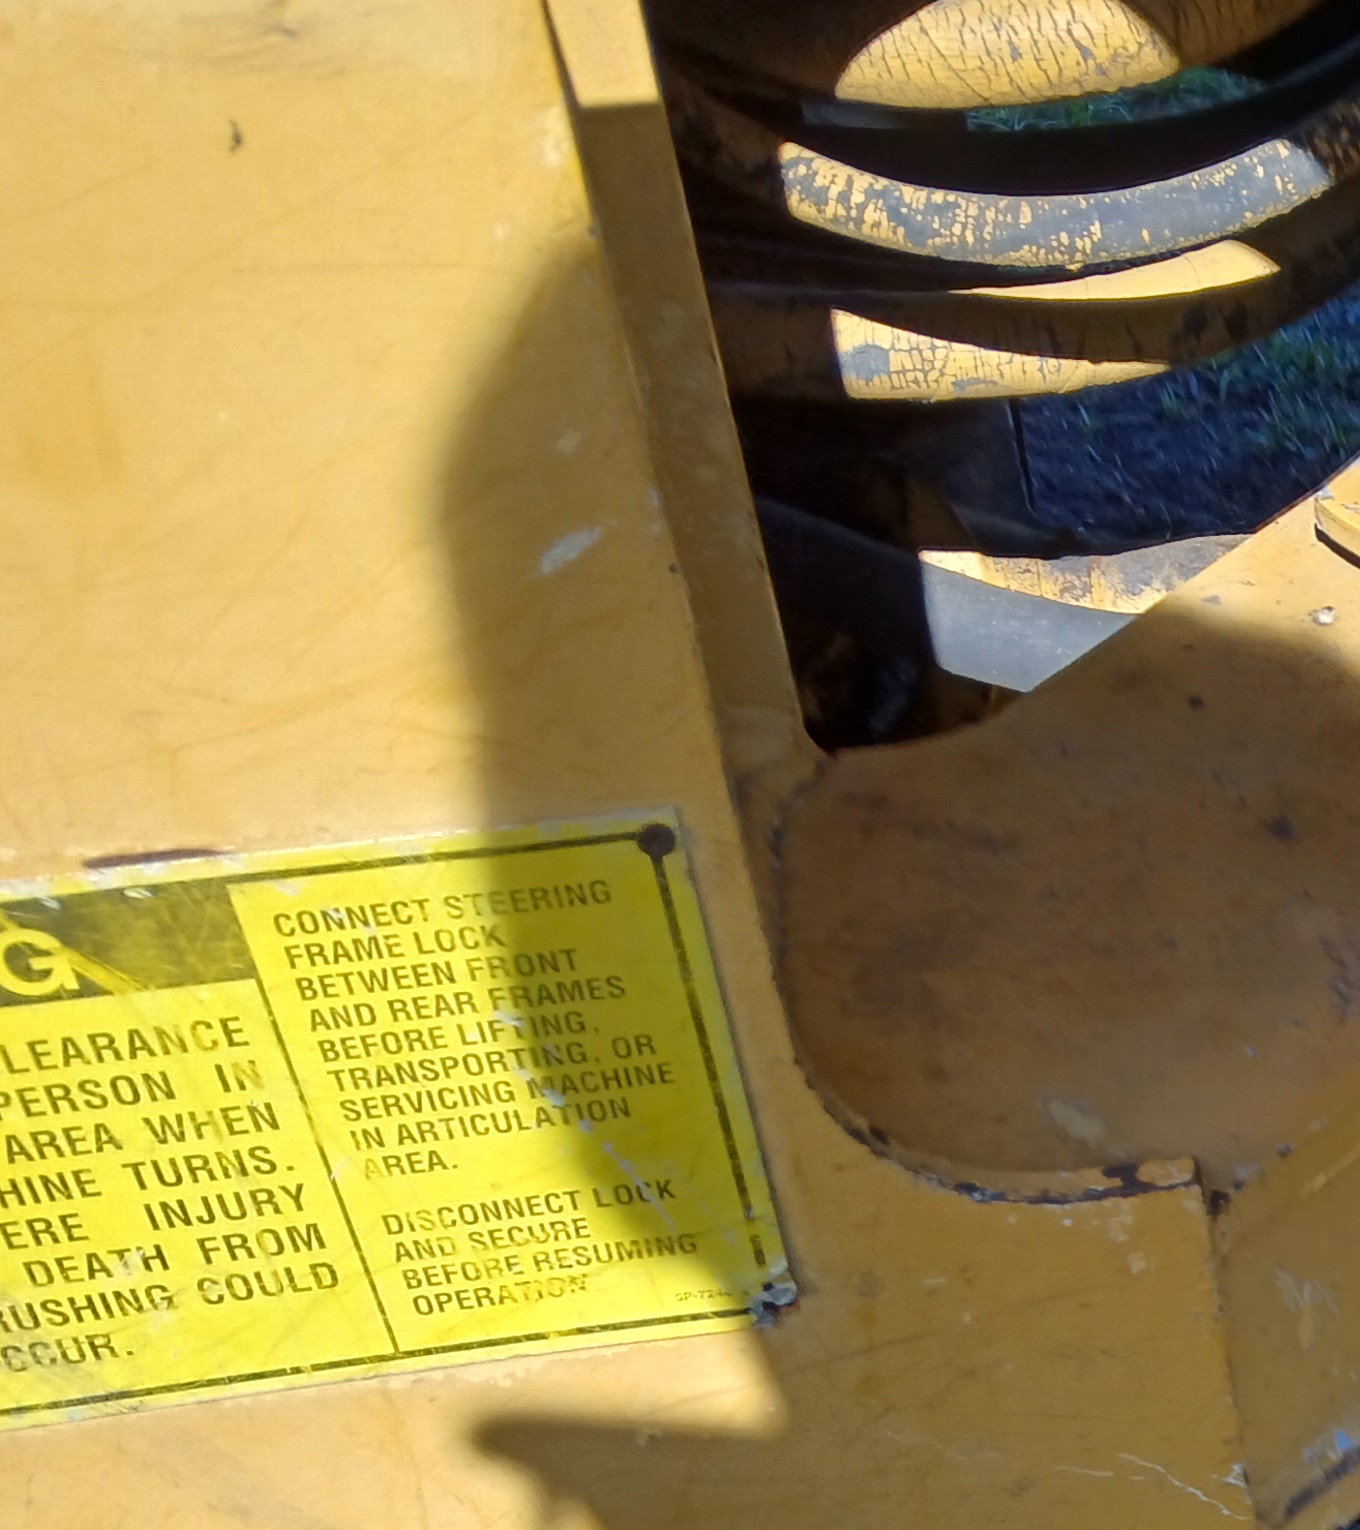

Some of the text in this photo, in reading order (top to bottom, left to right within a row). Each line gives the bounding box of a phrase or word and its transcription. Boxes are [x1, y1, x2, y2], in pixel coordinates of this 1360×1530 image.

[273, 879, 612, 937] CONNECT STEERING
[283, 923, 507, 969] FRAME LOCK
[295, 948, 577, 1001] BETWEEN FRONT
[310, 975, 627, 1032] AND REAR FRAMES
[317, 1011, 600, 1063] BEFORE LIFTING,
[326, 1033, 657, 1092] TRANSPORTING, OR
[0, 1060, 266, 1121] PERSON IN
[339, 1061, 676, 1122] SERVICING MACHINE
[4, 1102, 281, 1164] AREA WHEN
[349, 1096, 632, 1151] IN ARTICULATION
[121, 1145, 295, 1190] TURNS.
[363, 1149, 459, 1180] AREA.
[143, 1183, 305, 1231] INJURY
[381, 1179, 676, 1236] DISCONNECT LOCK
[22, 1222, 327, 1287] DEATH FROM
[395, 1217, 591, 1263] AND SECURE
[401, 1233, 698, 1290] BEFORE RESUMING
[196, 1262, 339, 1305] COULD
[412, 1272, 589, 1316] OPERATION
